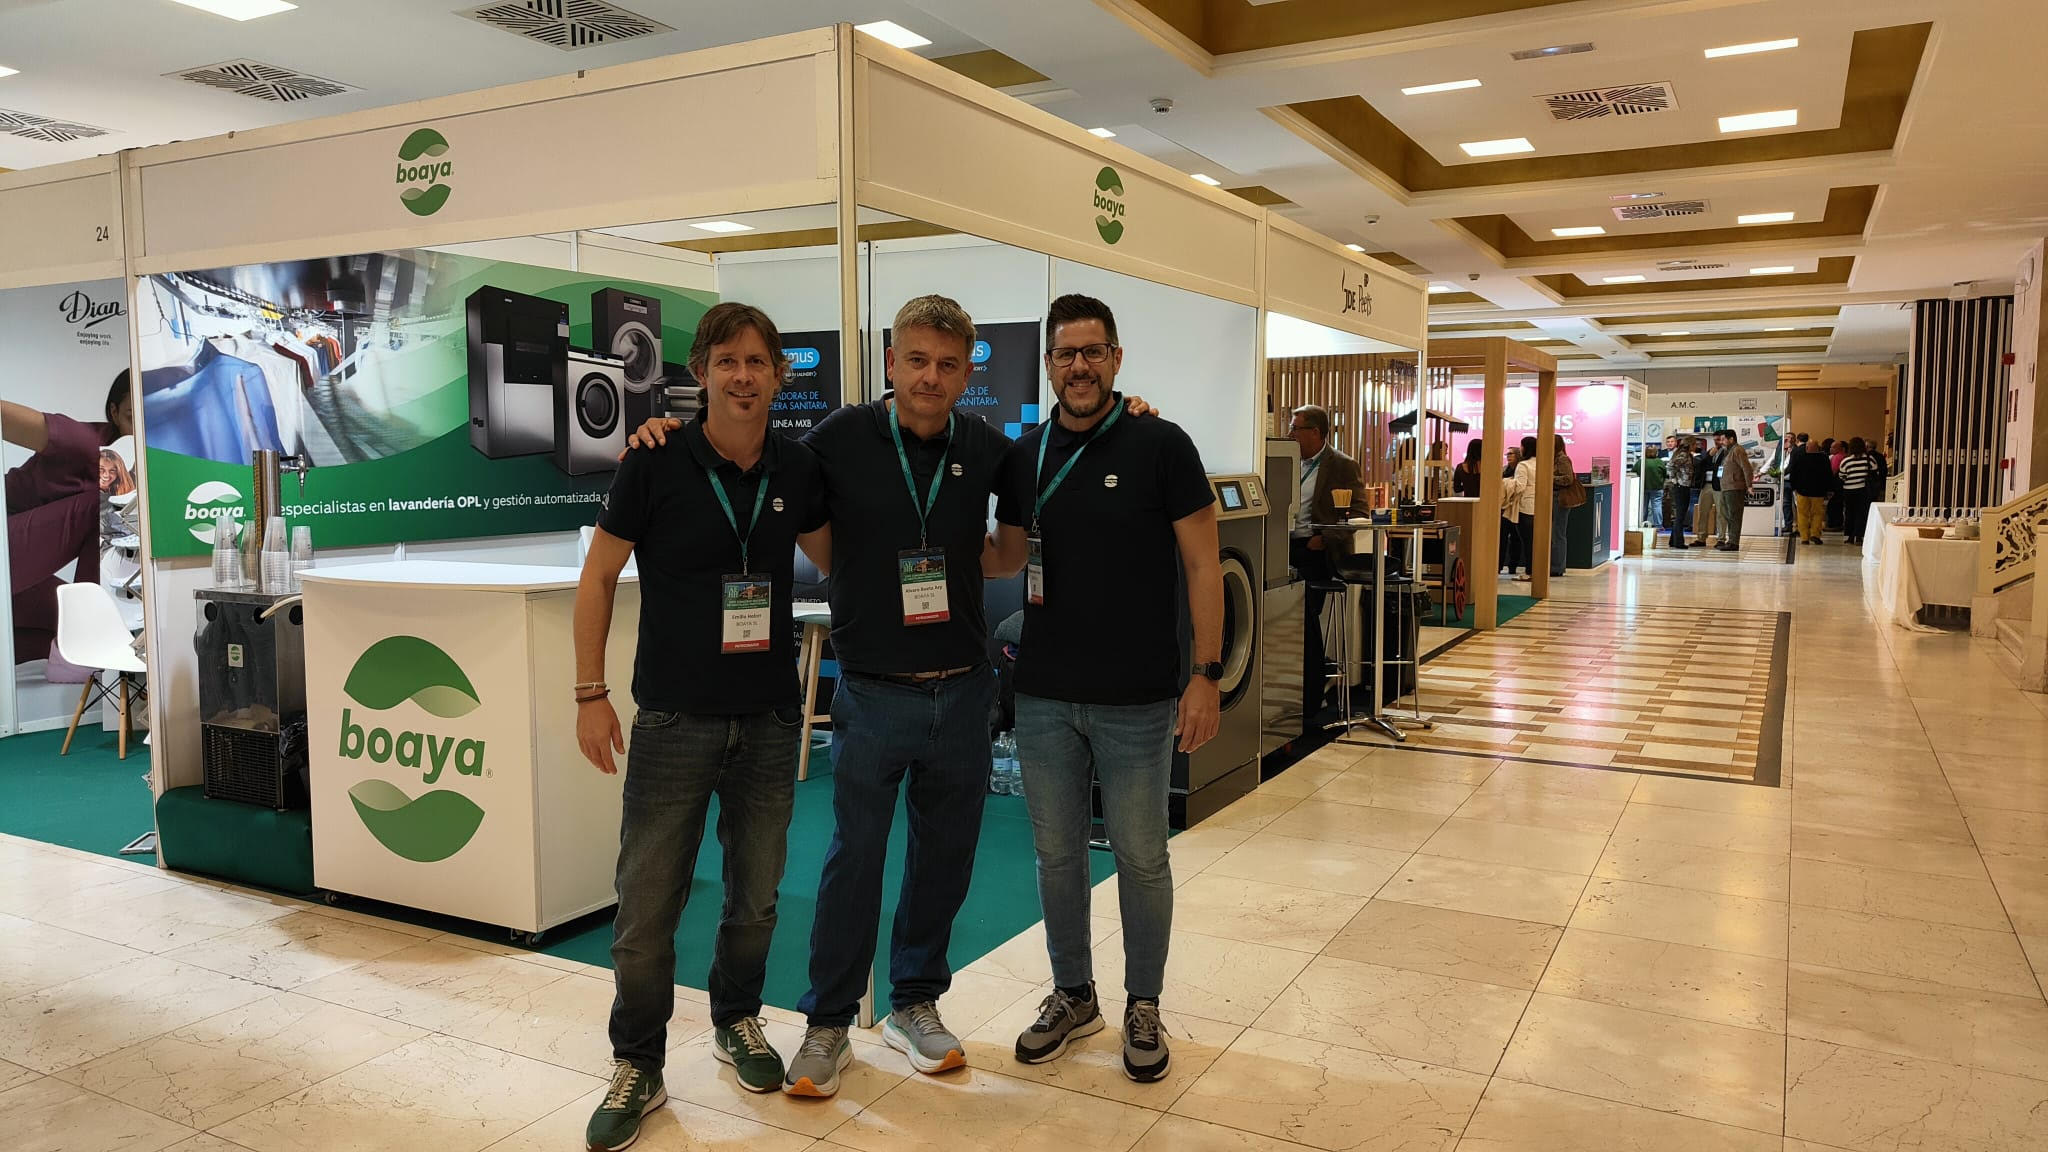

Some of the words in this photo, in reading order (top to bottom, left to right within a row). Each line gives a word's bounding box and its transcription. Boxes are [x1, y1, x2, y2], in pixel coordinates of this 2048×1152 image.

[396, 161, 452, 184] boaya
[1094, 189, 1125, 218] boaya
[96, 226, 109, 241] 24
[59, 290, 127, 329] Dian
[777, 391, 807, 400] ADORAS
[810, 391, 819, 399] DE
[978, 387, 988, 395] DE
[789, 401, 828, 410] SANITARIA
[955, 397, 998, 406] SANITARIA
[1671, 401, 1698, 409] A.M.C.
[371, 501, 385, 512] en
[389, 496, 454, 511] lavandería
[457, 495, 482, 508] OPL
[483, 498, 490, 510] y
[492, 493, 531, 509] gestión
[534, 491, 602, 505] automatizada
[339, 708, 485, 784] boaya
